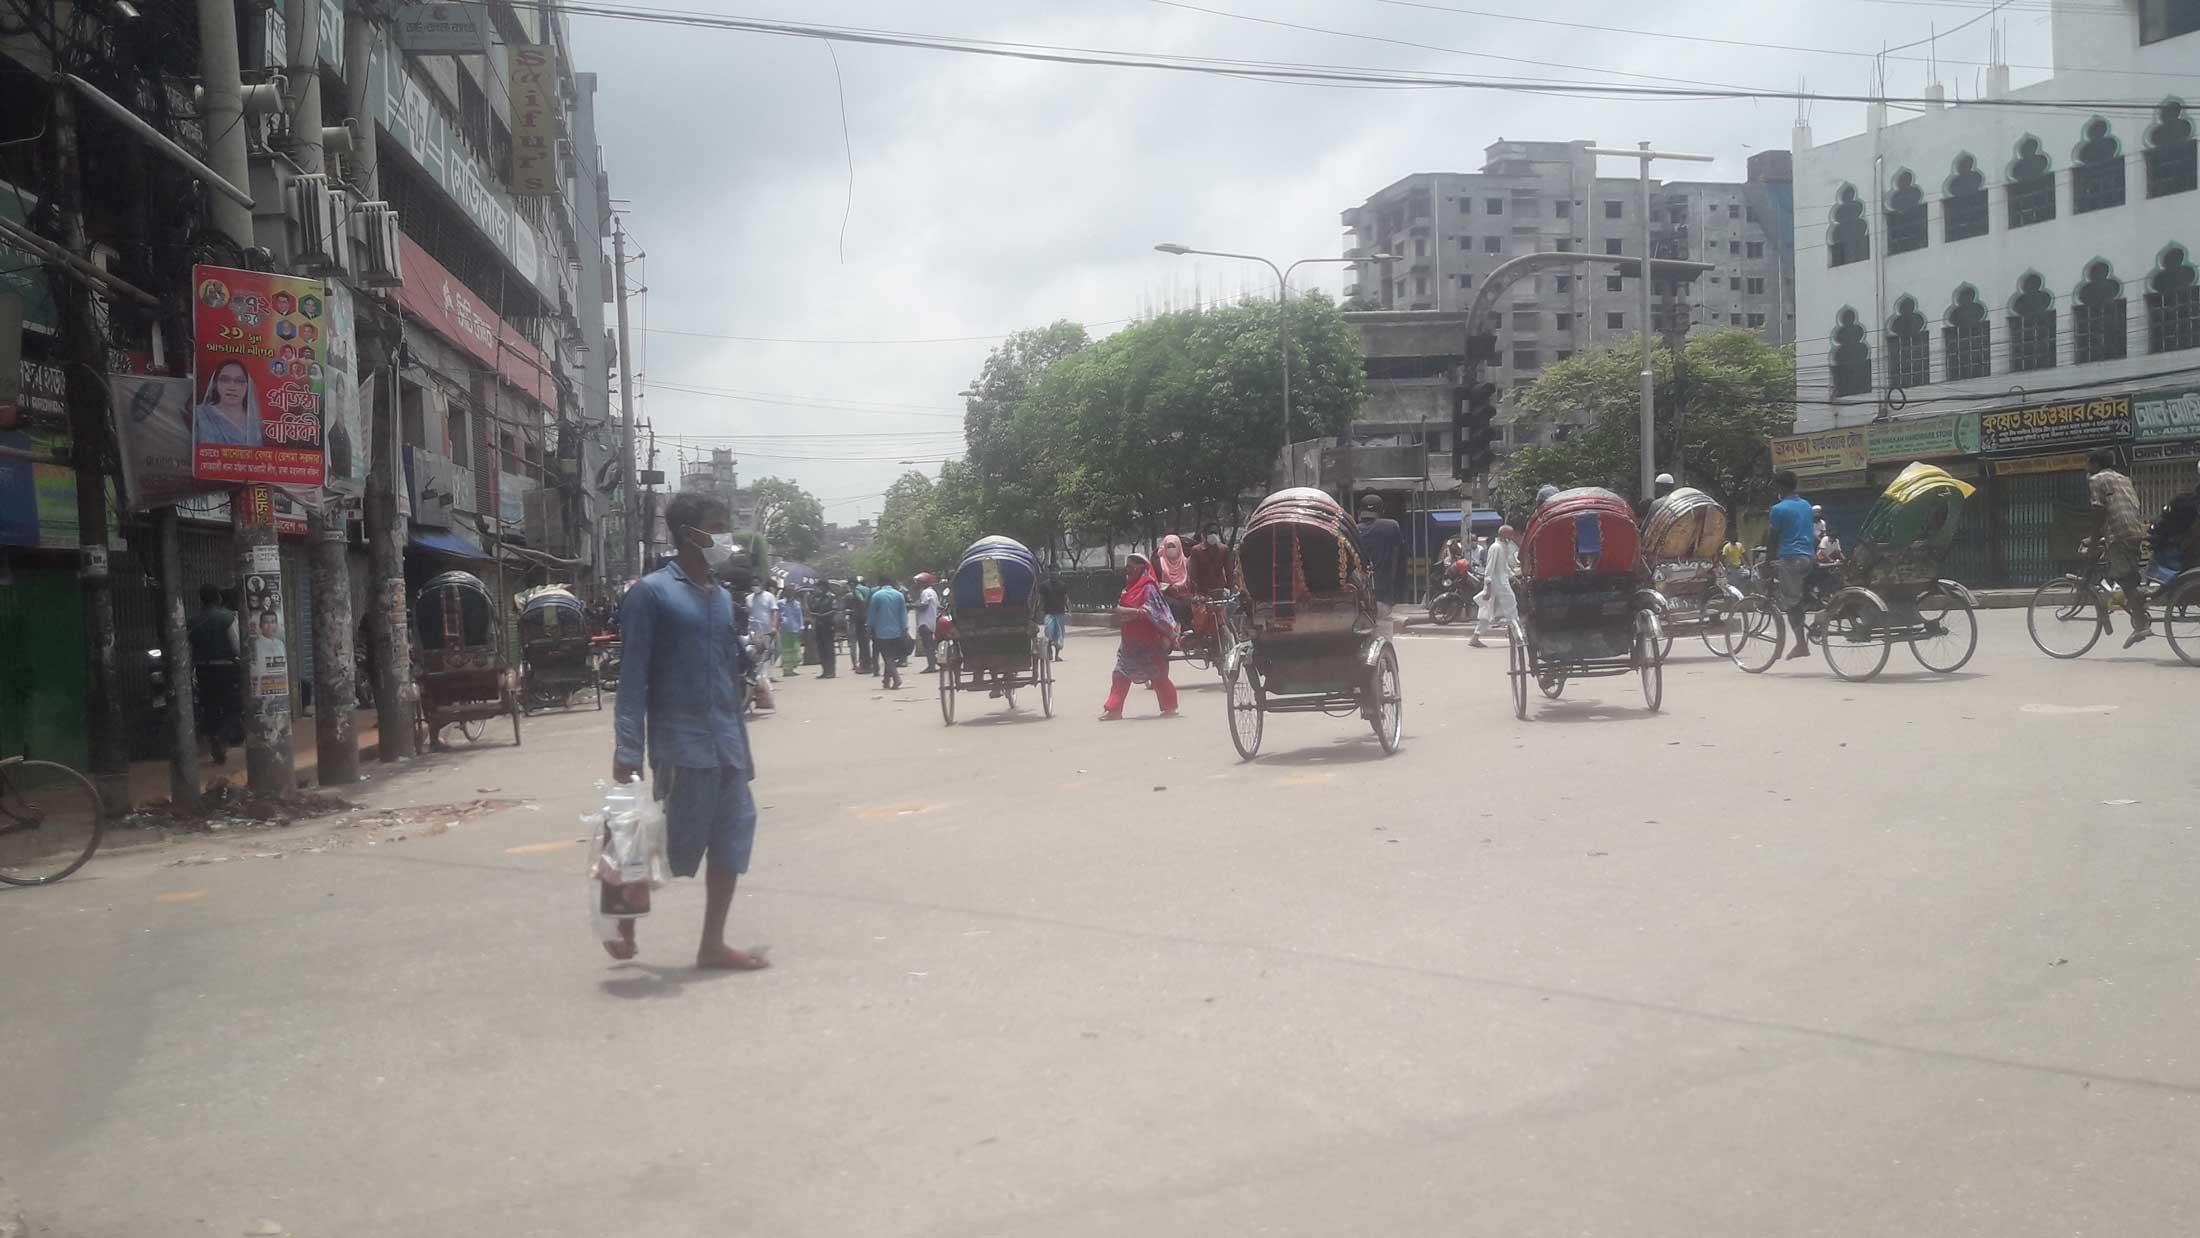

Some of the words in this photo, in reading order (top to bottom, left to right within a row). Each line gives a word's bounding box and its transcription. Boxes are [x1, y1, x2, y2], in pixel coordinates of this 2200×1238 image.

[266, 381, 321, 415] প্রতিষ্ঠা
[263, 412, 321, 447] বার্ষিকী
[1983, 411, 2021, 434] কুয়েত
